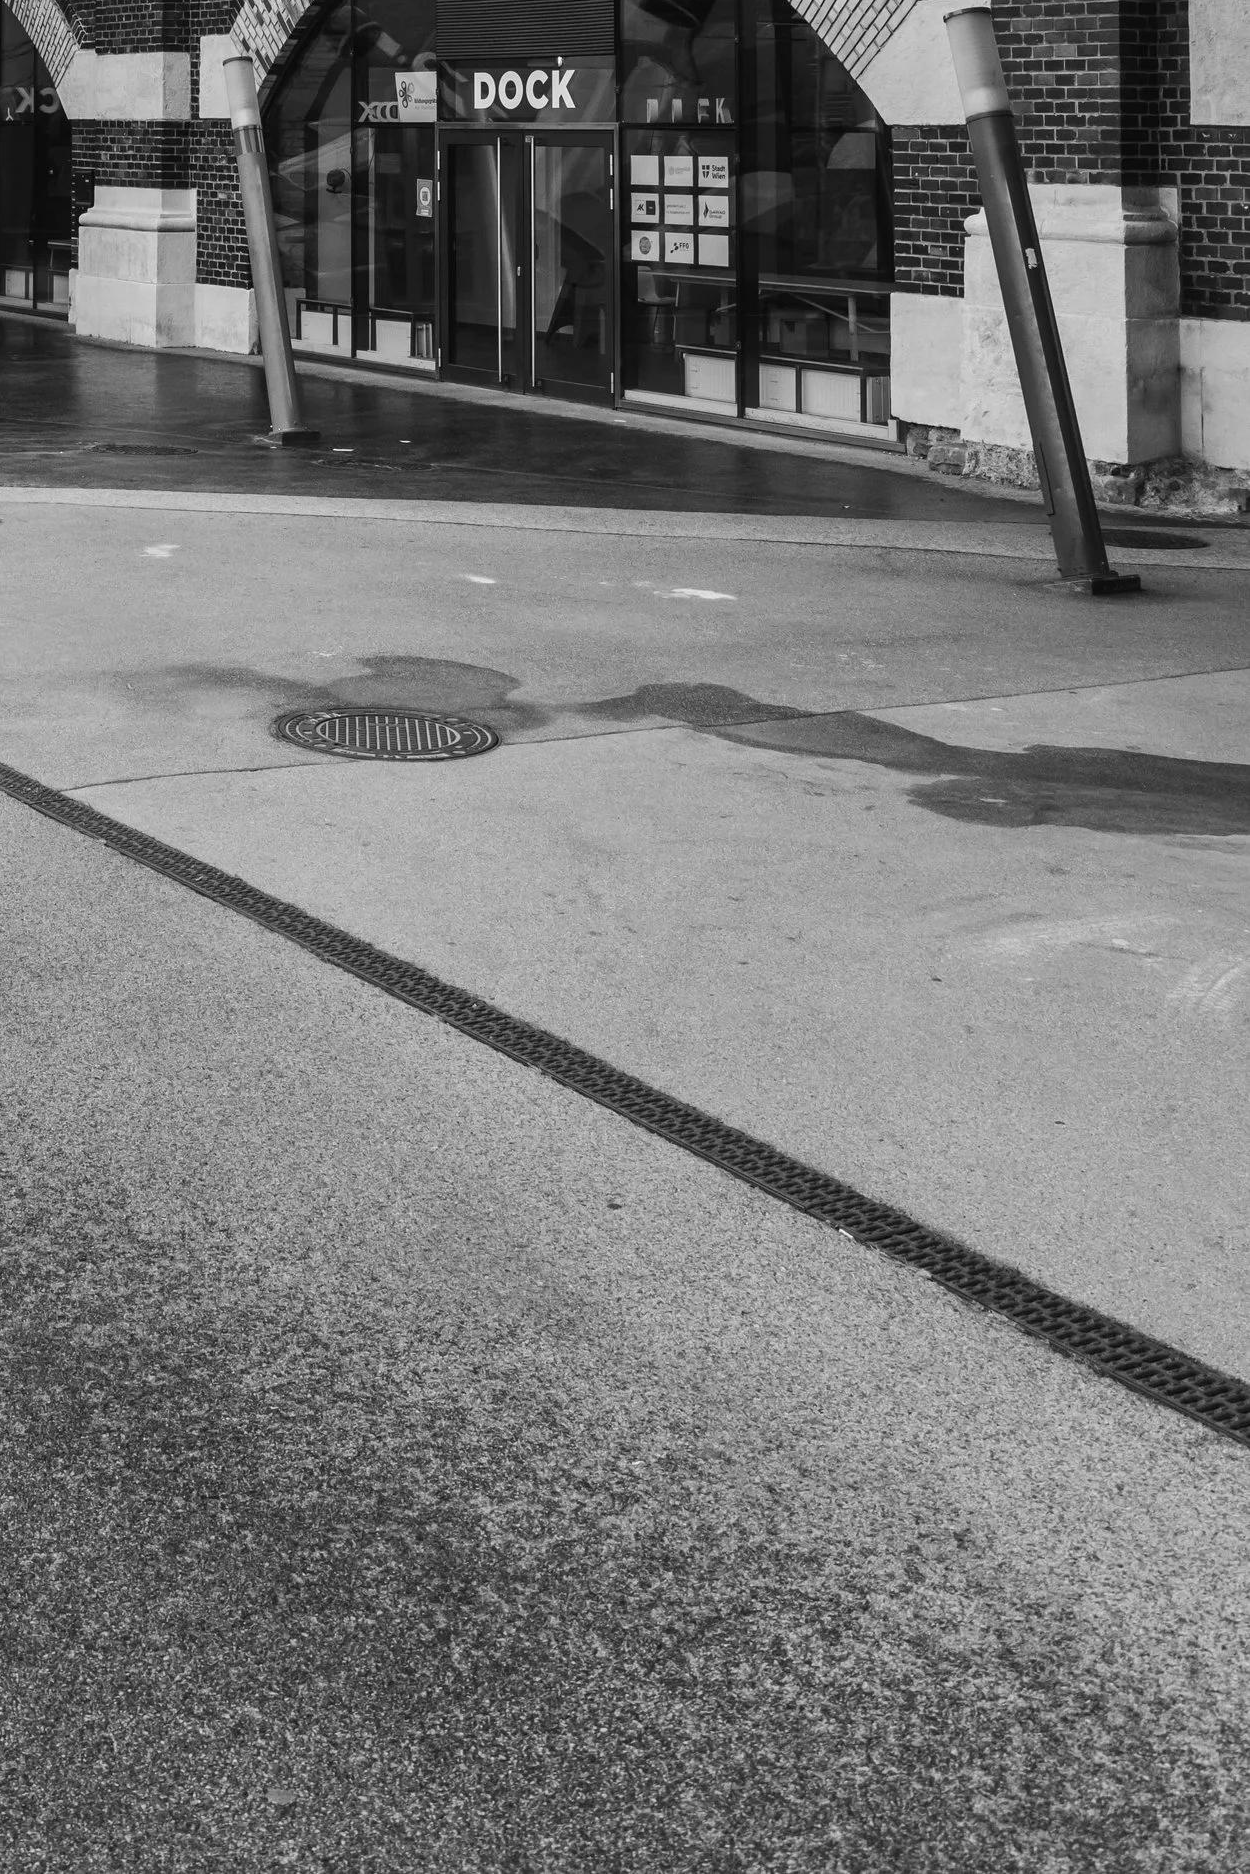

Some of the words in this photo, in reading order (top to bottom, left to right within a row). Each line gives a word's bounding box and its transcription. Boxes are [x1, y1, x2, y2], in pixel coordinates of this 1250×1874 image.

[474, 69, 576, 110] DOCK
[711, 164, 726, 172] Stadt
[711, 172, 726, 180] Wien
